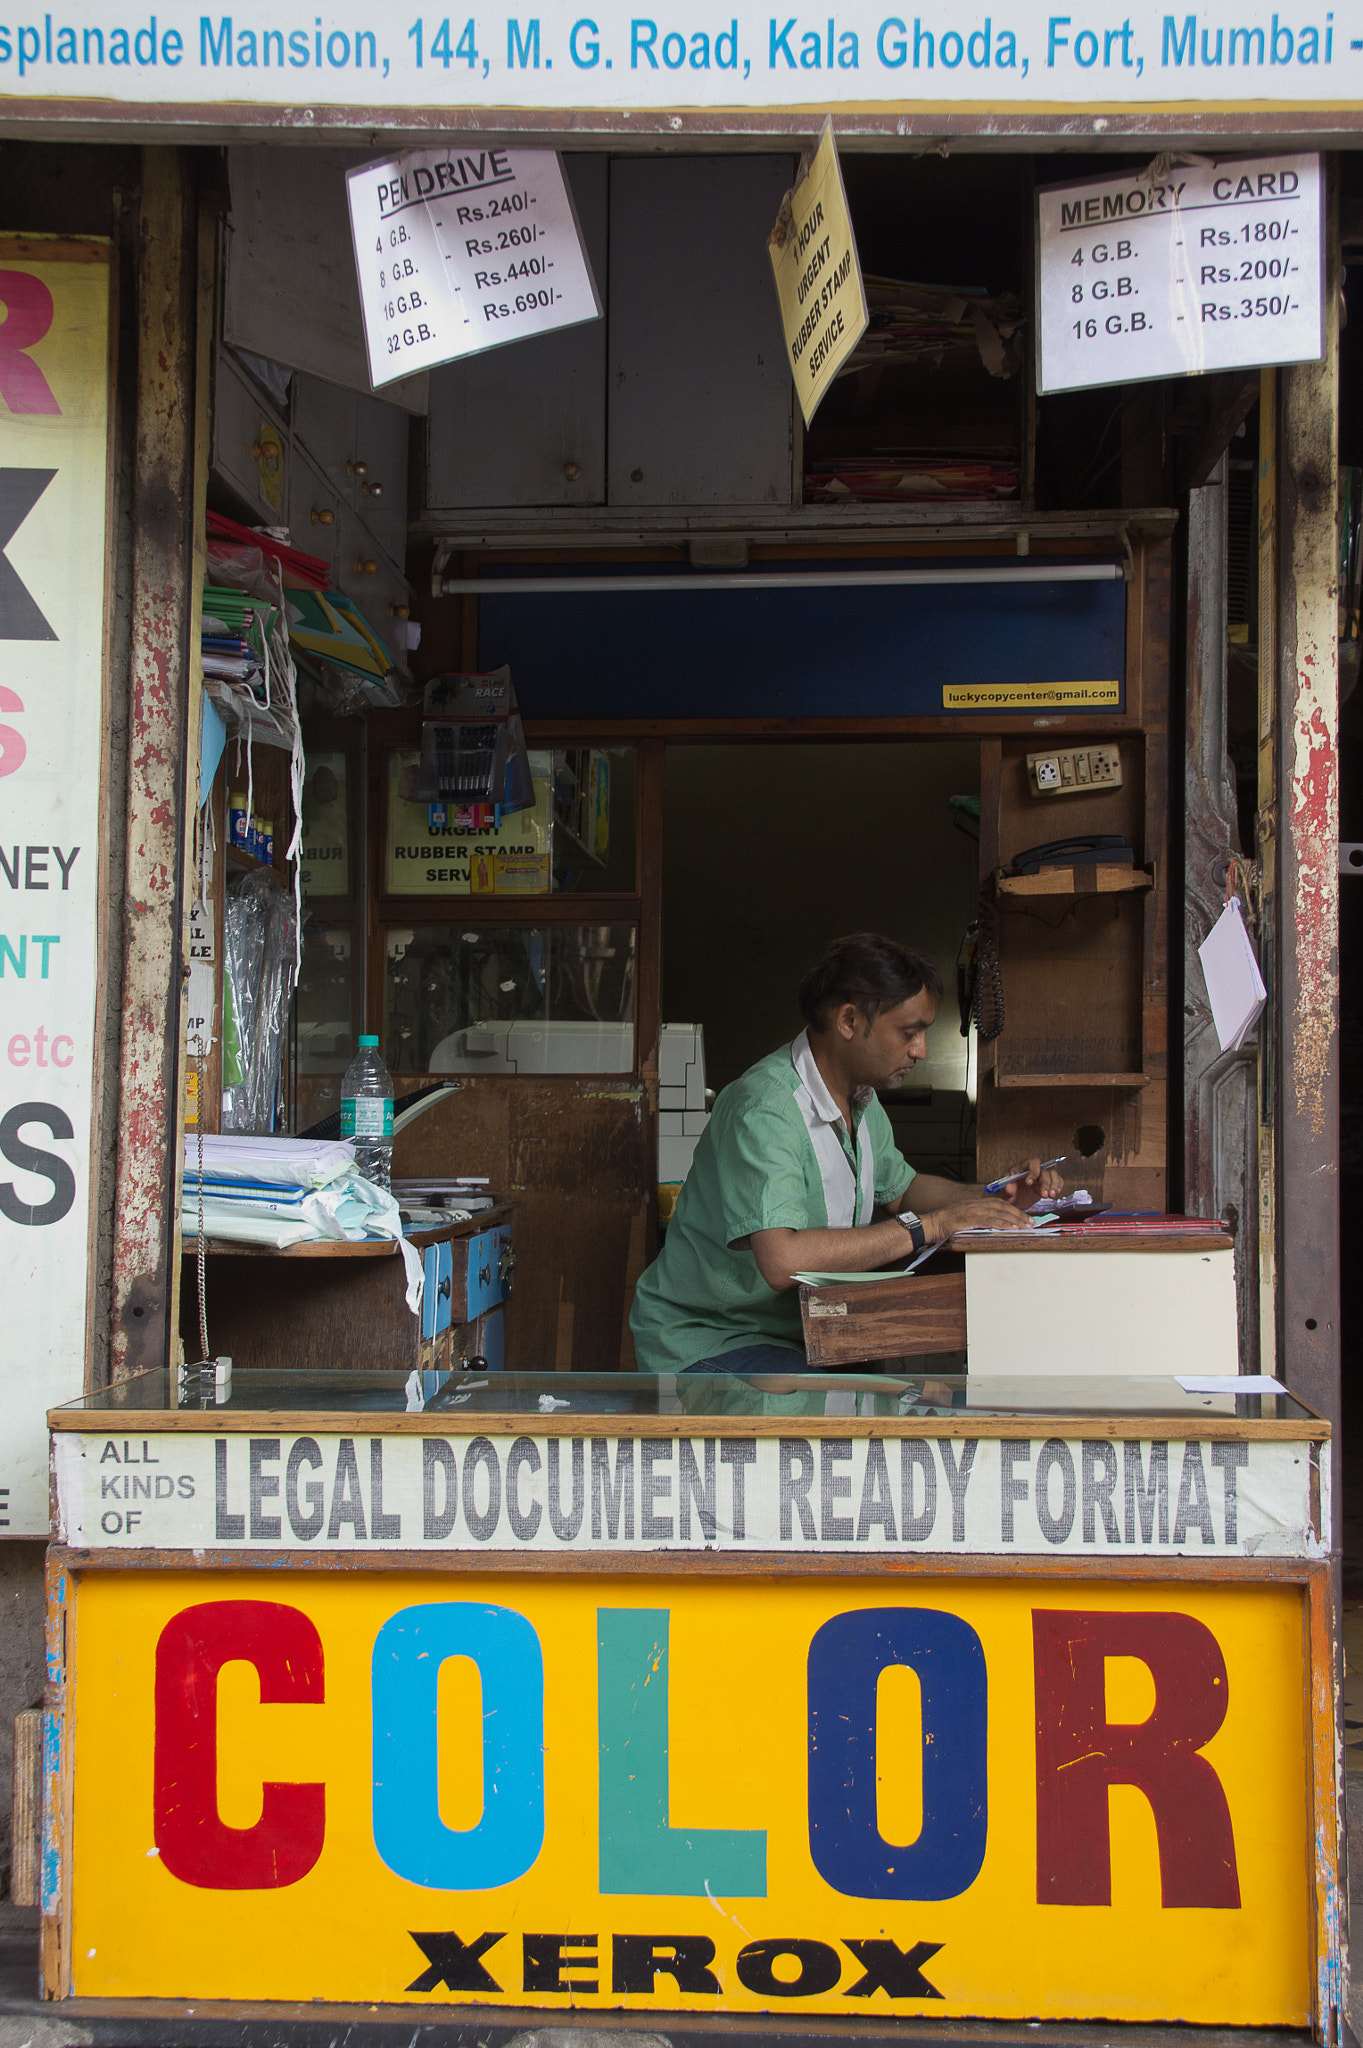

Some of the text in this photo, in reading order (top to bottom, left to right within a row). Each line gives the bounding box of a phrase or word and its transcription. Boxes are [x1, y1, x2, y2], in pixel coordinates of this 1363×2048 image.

[0, 13, 183, 77] splanade
[199, 16, 390, 78] Mansion,
[407, 18, 490, 79] 144,
[507, 18, 553, 69] M.
[569, 18, 613, 69] G.
[630, 18, 751, 79] Road,
[768, 18, 860, 69] Kala
[876, 17, 1029, 78] Ghoda,
[1047, 16, 1145, 78] Fort,
[1161, 12, 1334, 67] Mumbai
[377, 150, 513, 212] PEN DRIVE
[1061, 171, 1299, 226] MEMORY CARD
[375, 236, 383, 254] 4
[389, 224, 411, 248] G.B.
[456, 191, 537, 226] Rs.240/-
[797, 201, 825, 257] HOUR
[1071, 247, 1084, 267] 4
[1091, 239, 1139, 264] G.B.
[1200, 219, 1299, 248] Rs.180/-
[379, 270, 386, 289] 8
[392, 258, 419, 281] G.B.
[465, 223, 546, 258] Rs.260/-
[797, 235, 831, 305] URGENT
[1071, 283, 1084, 304] 8
[1091, 276, 1139, 300] G.B.
[1200, 257, 1299, 286] Rs.200/-
[383, 301, 395, 321] 16
[396, 290, 427, 314] G.B.
[474, 256, 554, 290] Rs.440/-
[791, 249, 852, 365] RUBBER STAMP
[1072, 318, 1098, 340] 16
[1105, 311, 1153, 335] G.B.
[1201, 294, 1299, 323] Rs.350/-
[386, 333, 401, 354] 32
[402, 323, 436, 346] G.B.
[483, 288, 563, 321] Rs.690/-
[809, 310, 845, 379] SERVICE
[475, 687, 505, 698] RACE
[949, 689, 1117, 703] luckycopycenter@gmail.com
[394, 846, 468, 859] RUBBER
[7, 1024, 75, 1068] etc
[99, 1440, 160, 1464] ALL
[100, 1474, 196, 1500] KINDS
[214, 1436, 1249, 1545] LEGAL DOCUMENT READY FORMAT
[100, 1510, 142, 1535] OF
[153, 1599, 1242, 1909] COLOR
[405, 1930, 946, 2000] XEROX
